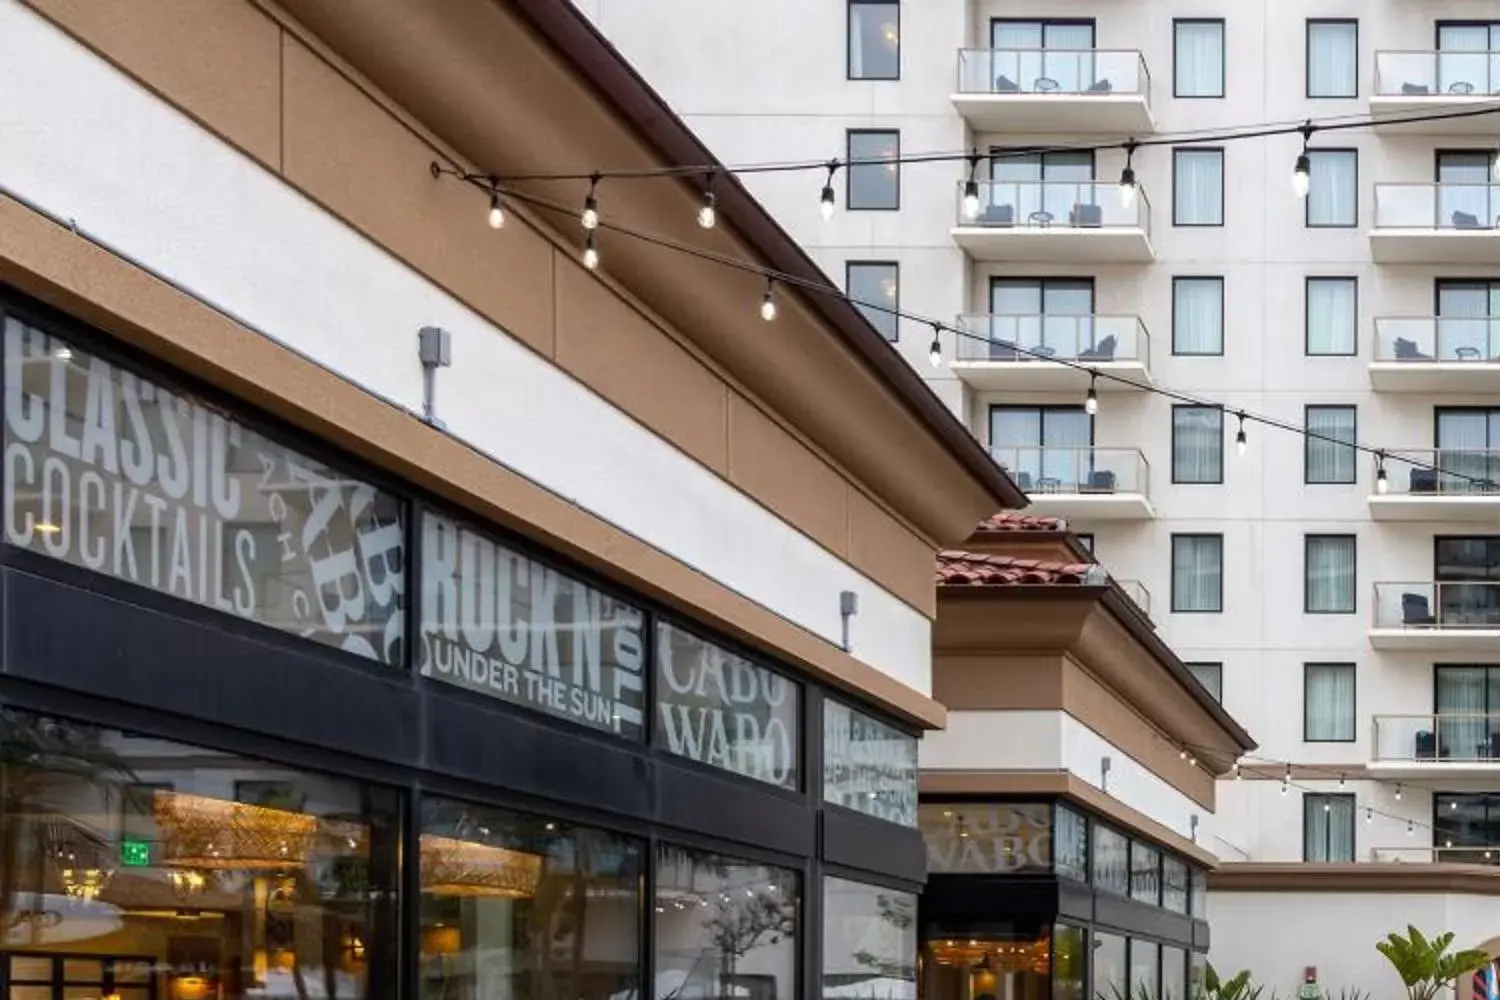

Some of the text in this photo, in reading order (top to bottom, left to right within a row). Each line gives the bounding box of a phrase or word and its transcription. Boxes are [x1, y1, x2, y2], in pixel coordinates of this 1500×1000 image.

[4, 316, 241, 519] CLASSIC
[4, 442, 256, 617] COCKTAILS
[434, 640, 611, 725] UNDER THE SUN
[659, 701, 792, 785] WABO
